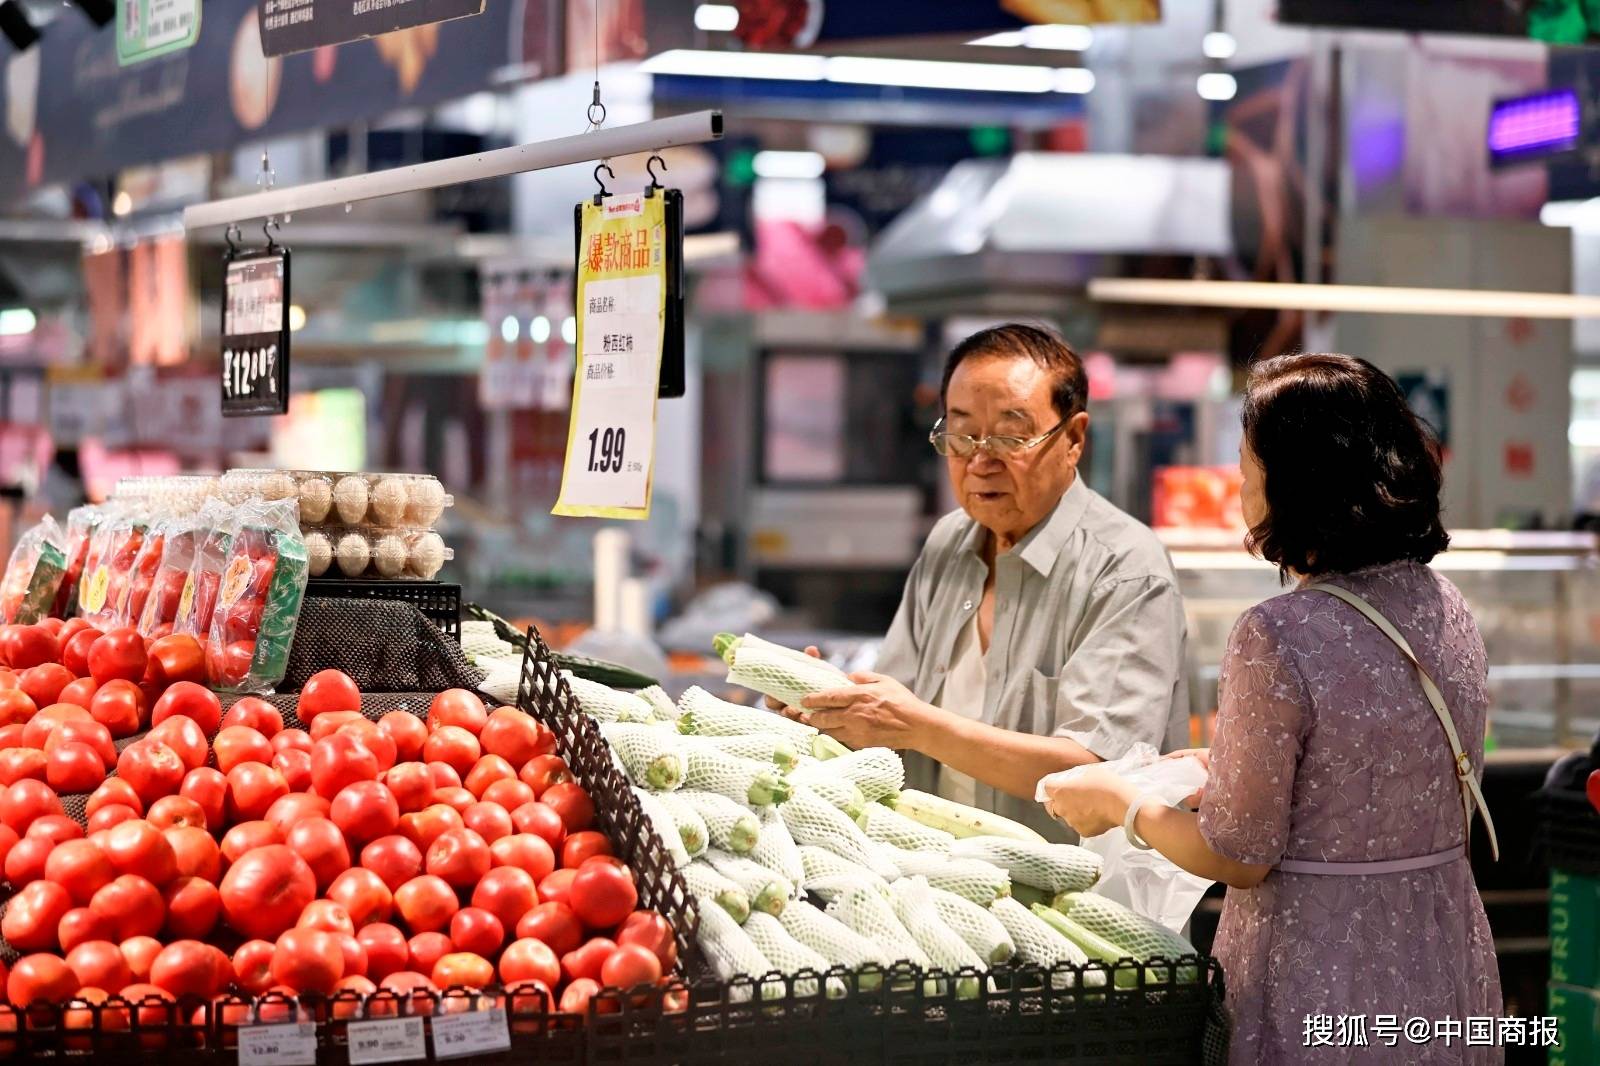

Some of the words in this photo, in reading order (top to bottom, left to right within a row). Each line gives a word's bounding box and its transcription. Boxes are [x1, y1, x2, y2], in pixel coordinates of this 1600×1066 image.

[587, 228, 651, 273] 爆款商品
[603, 333, 633, 353] 粉西红柿
[588, 427, 625, 473] 1.99
[1551, 871, 1569, 982] FRUIT
